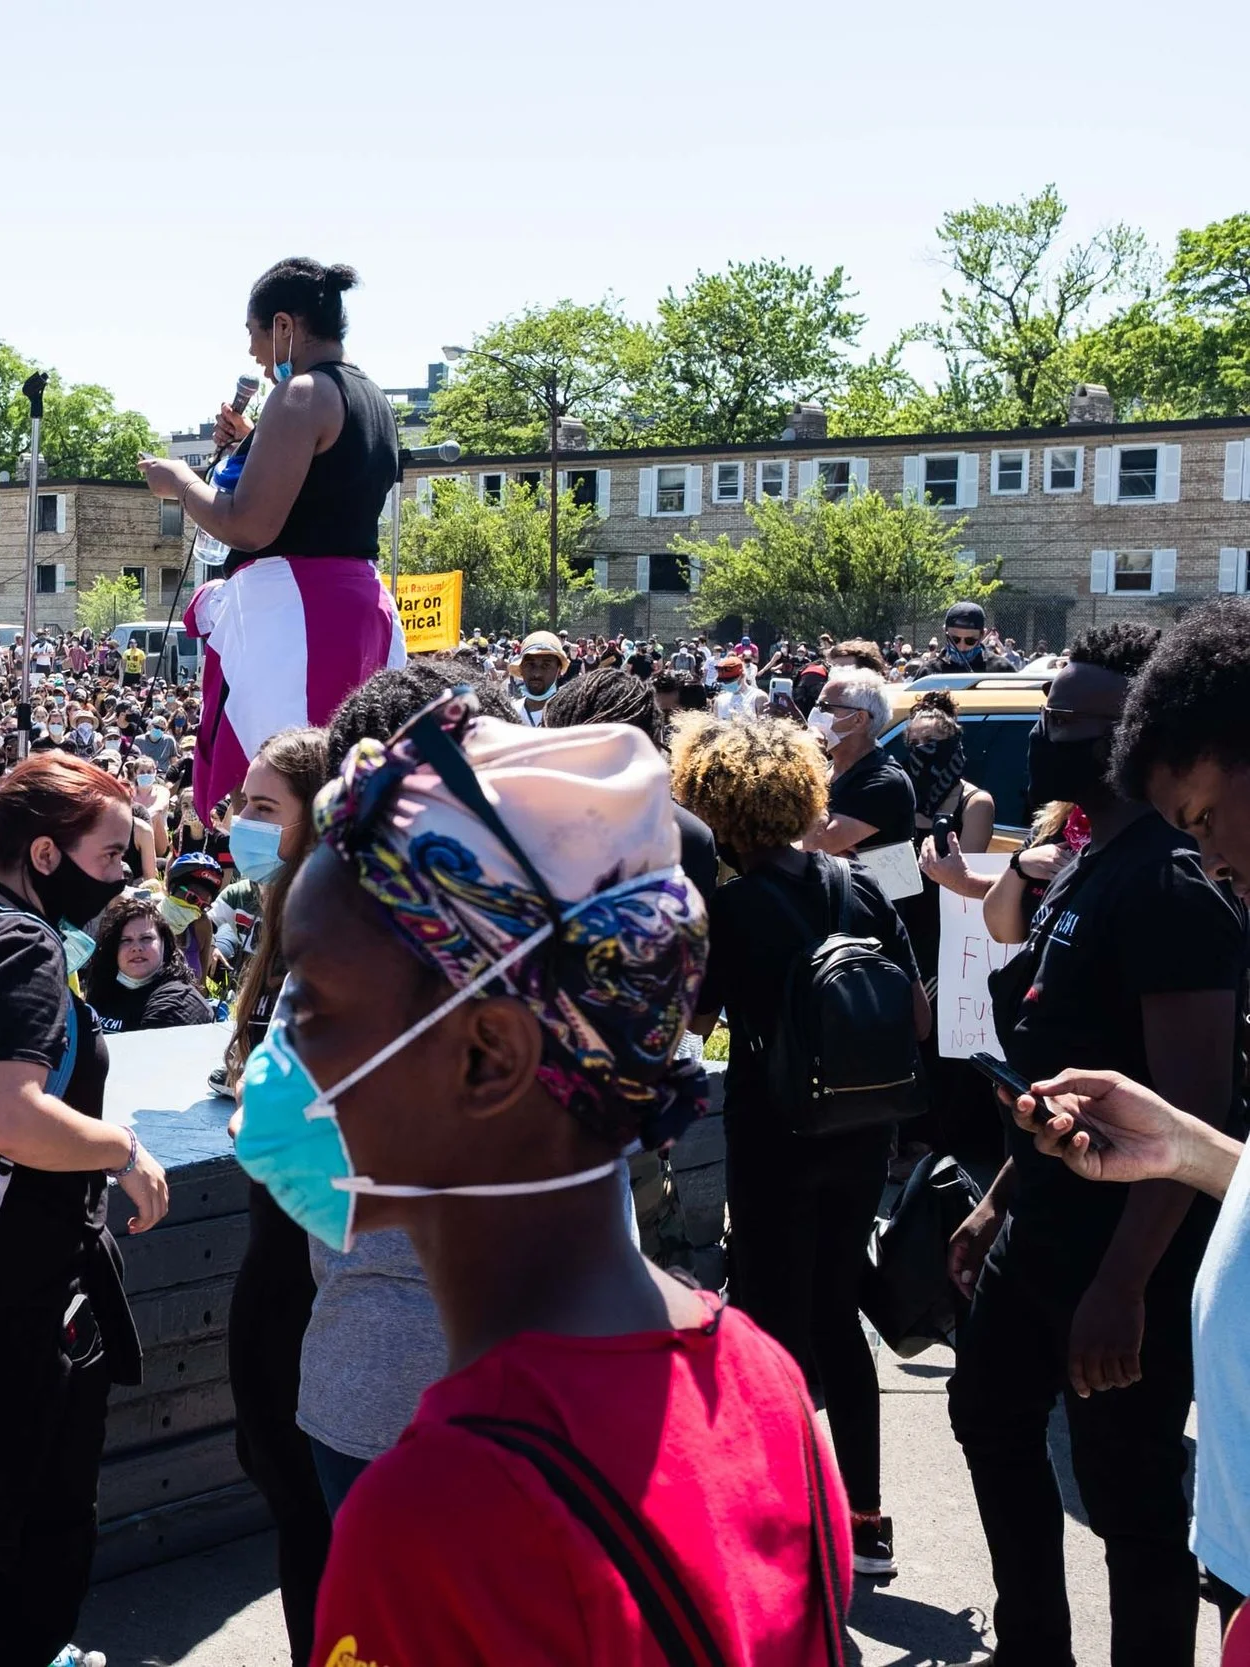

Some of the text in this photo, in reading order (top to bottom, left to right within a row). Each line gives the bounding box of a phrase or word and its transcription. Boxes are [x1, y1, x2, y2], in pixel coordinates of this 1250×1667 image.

[410, 581, 445, 593] Racism!
[423, 596, 442, 609] on
[958, 997, 994, 1023] FU
